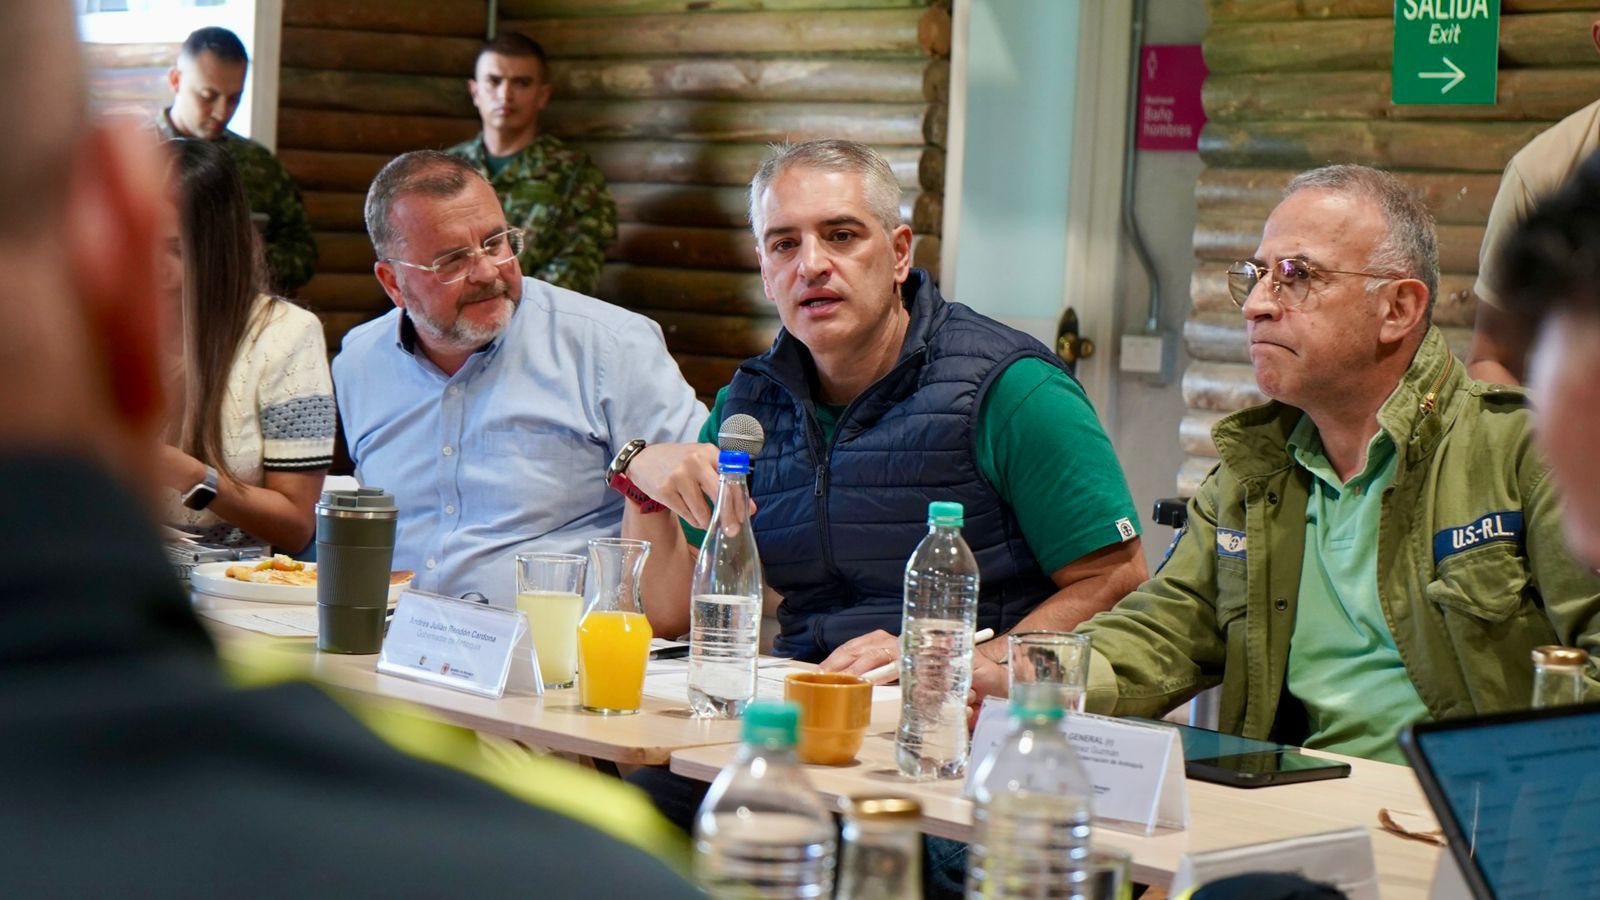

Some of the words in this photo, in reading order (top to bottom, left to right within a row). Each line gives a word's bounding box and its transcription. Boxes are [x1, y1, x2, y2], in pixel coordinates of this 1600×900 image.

[1403, 0, 1489, 20] SALIDA
[1428, 23, 1461, 44] Exit
[1144, 122, 1192, 137] hombres
[471, 630, 497, 642] Cardona
[1068, 732, 1103, 745] GENERAL
